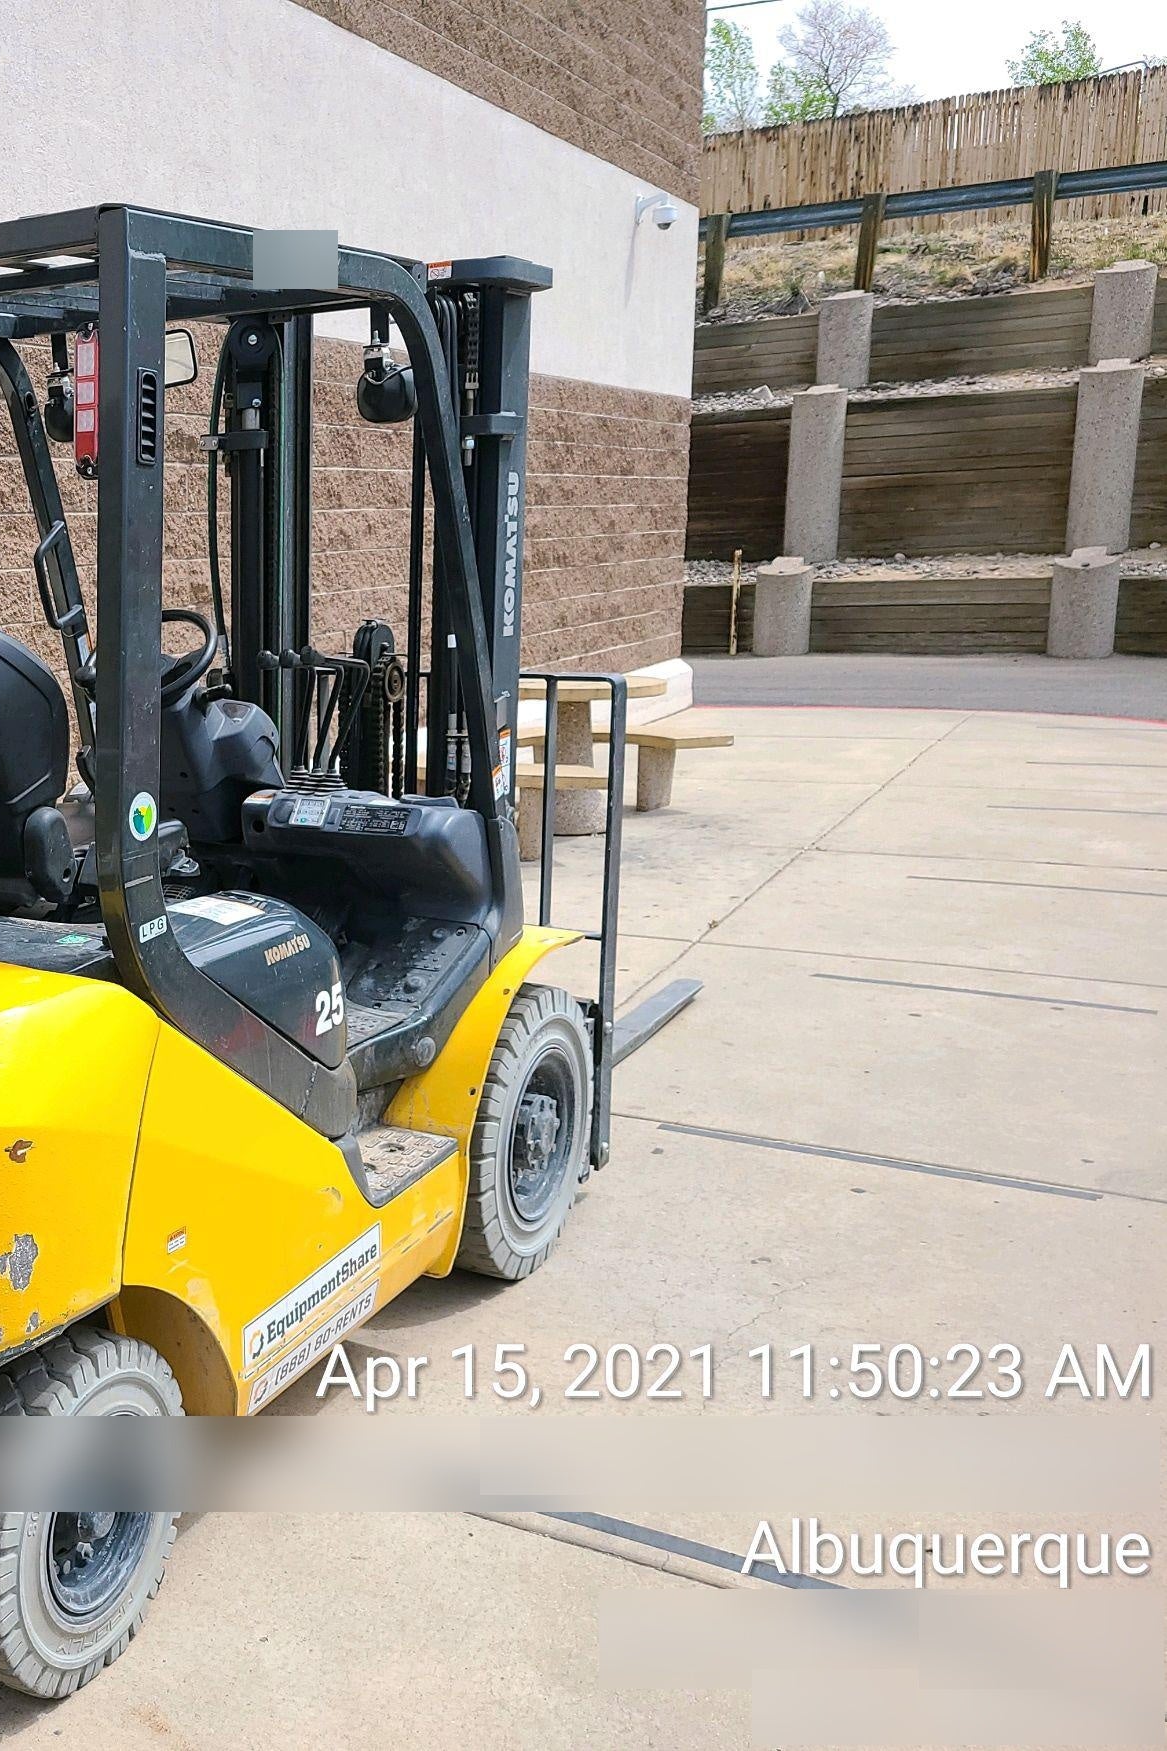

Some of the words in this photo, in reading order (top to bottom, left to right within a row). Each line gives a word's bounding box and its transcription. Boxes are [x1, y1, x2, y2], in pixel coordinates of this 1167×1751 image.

[502, 471, 520, 637] KOMATSU
[141, 919, 165, 938] LPG
[264, 933, 311, 966] KOMATSU
[315, 981, 344, 1037] 25
[266, 1243, 377, 1345] EquipmentShare
[273, 1343, 312, 1386] (888)
[314, 1292, 373, 1352] 80-RENTS
